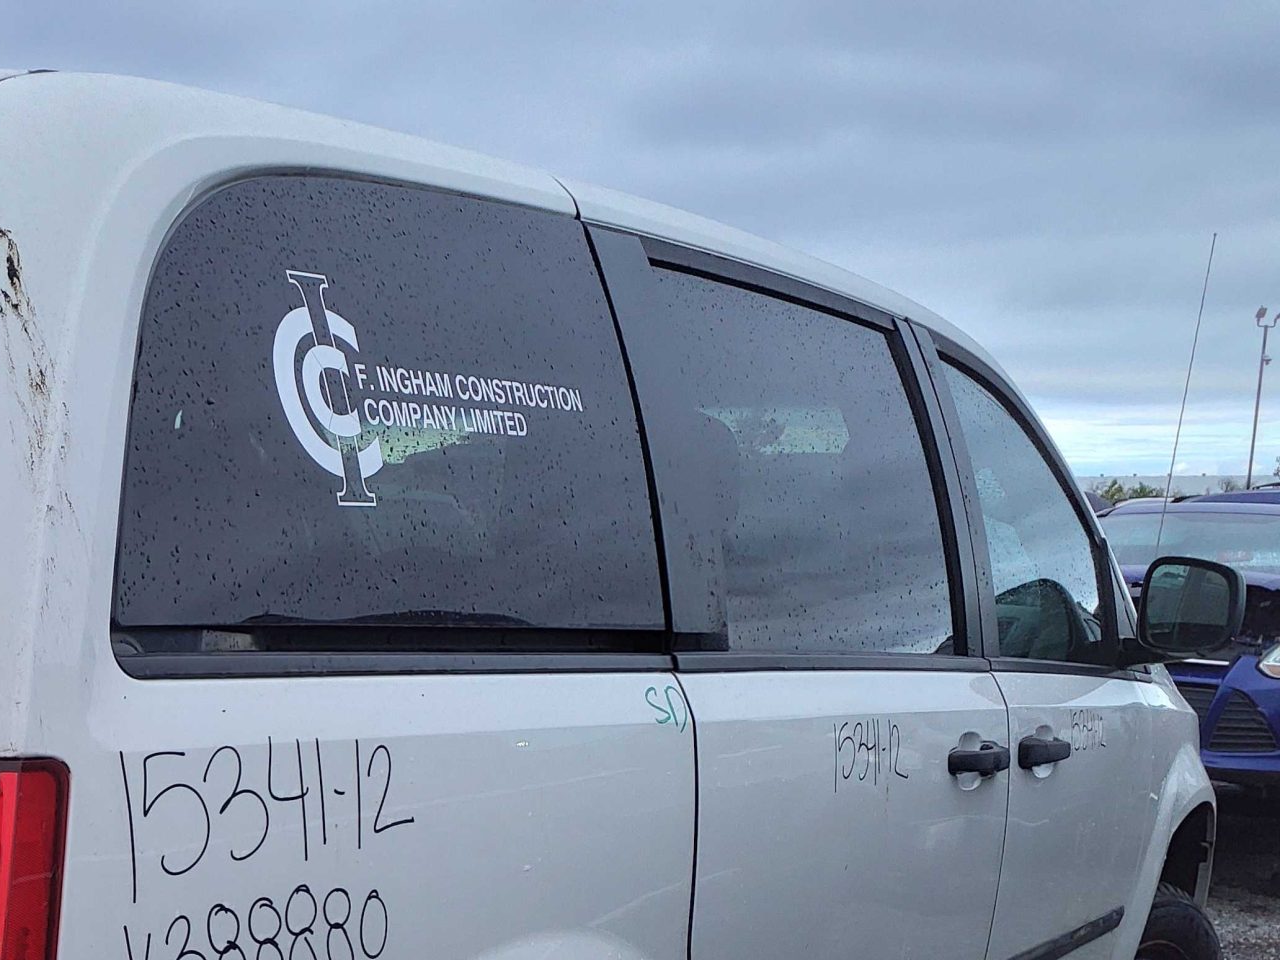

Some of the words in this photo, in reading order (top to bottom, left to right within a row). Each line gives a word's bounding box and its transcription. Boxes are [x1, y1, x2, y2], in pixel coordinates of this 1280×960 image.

[353, 362, 376, 391] F.
[377, 365, 454, 399] INGHAM
[455, 374, 584, 413] CONSTRUCTION
[363, 397, 457, 431] COMPANY
[461, 409, 529, 438] LIMITED
[833, 717, 909, 794] 15341-12
[119, 736, 415, 904] 15341-12
